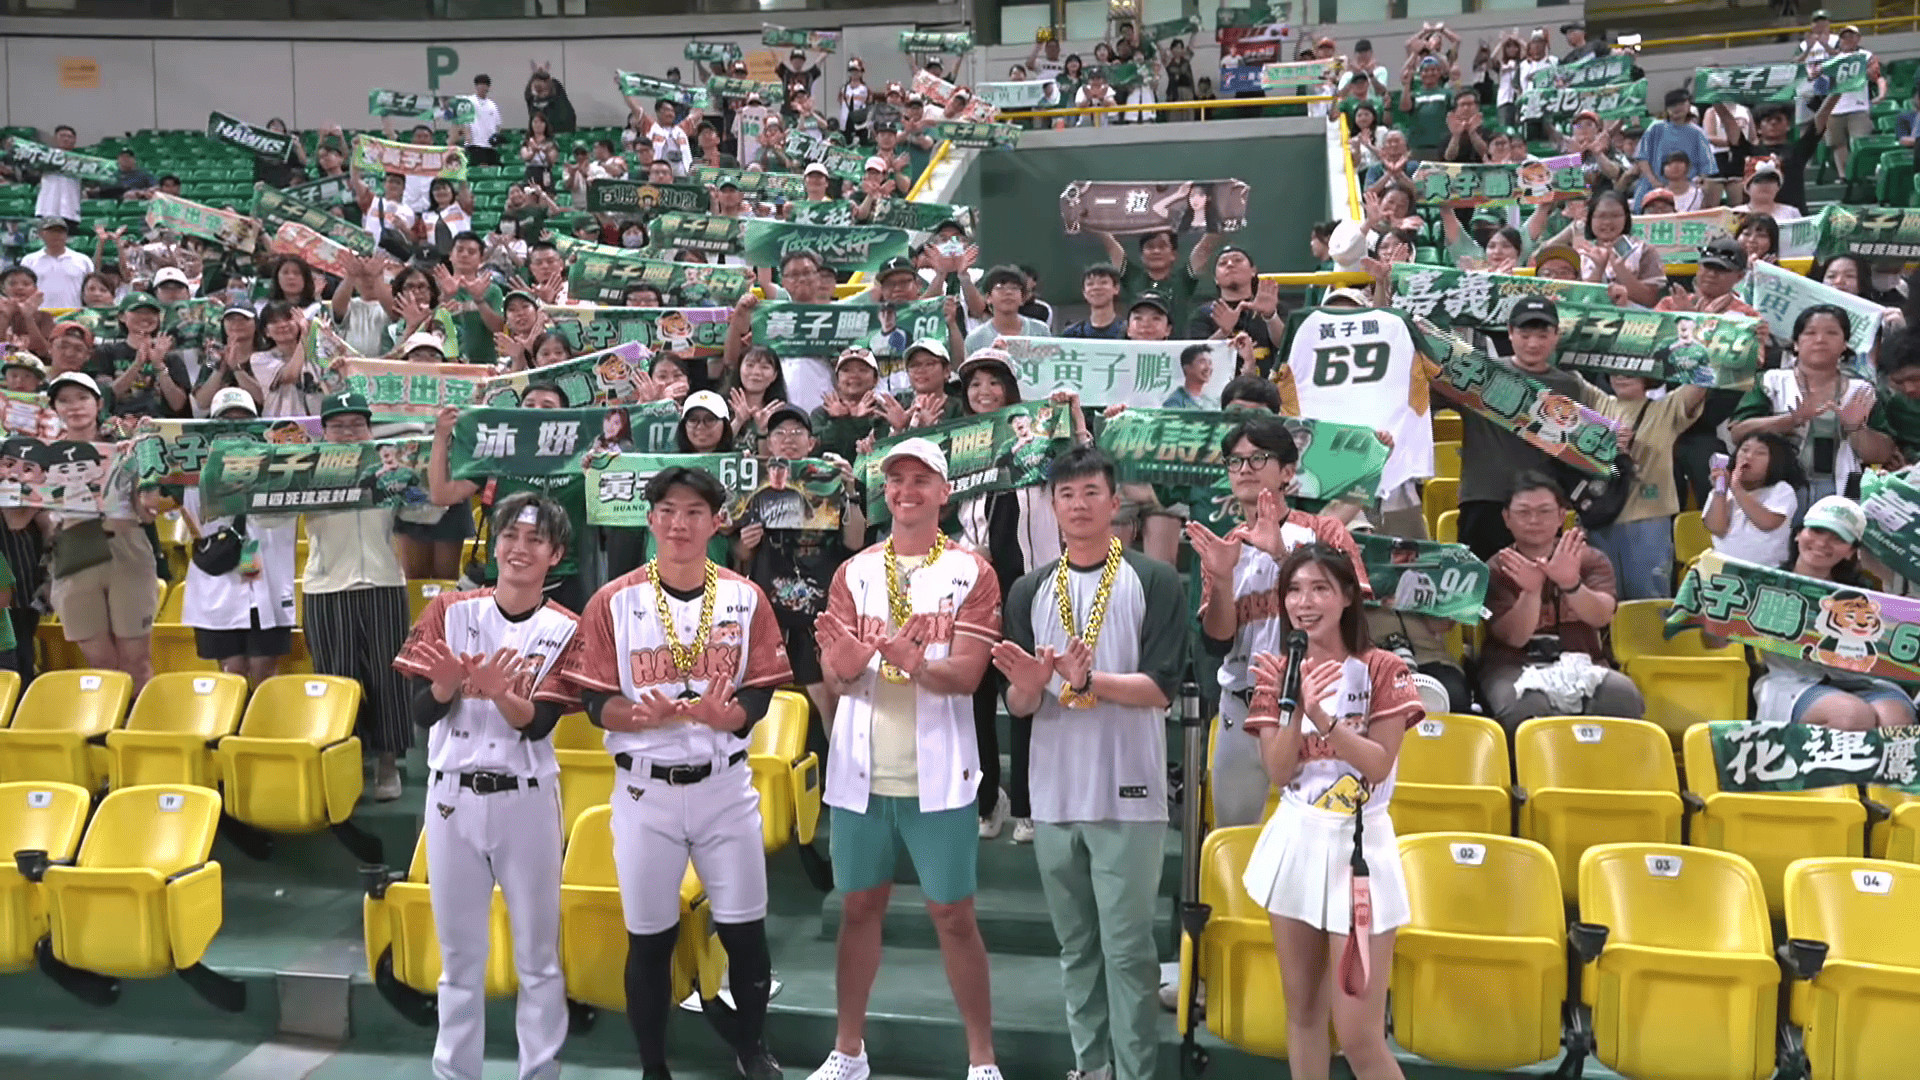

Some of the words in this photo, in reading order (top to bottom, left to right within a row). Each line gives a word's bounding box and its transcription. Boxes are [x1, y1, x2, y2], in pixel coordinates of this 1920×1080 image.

[427, 46, 458, 90] P
[1836, 61, 1861, 84] 69
[215, 121, 286, 152] HAWKS
[766, 310, 870, 339] 黃子鵬
[1319, 319, 1380, 341] 黃子鵬
[1050, 349, 1172, 393] 黃子鵬
[1312, 341, 1390, 387] 69
[472, 421, 581, 459] 沐妍
[719, 457, 759, 492] 69
[613, 504, 646, 512] HUANG
[1422, 723, 1436, 733] 02
[1459, 847, 1475, 859] 02
[1655, 859, 1671, 872] 03
[1863, 875, 1881, 888] 04
